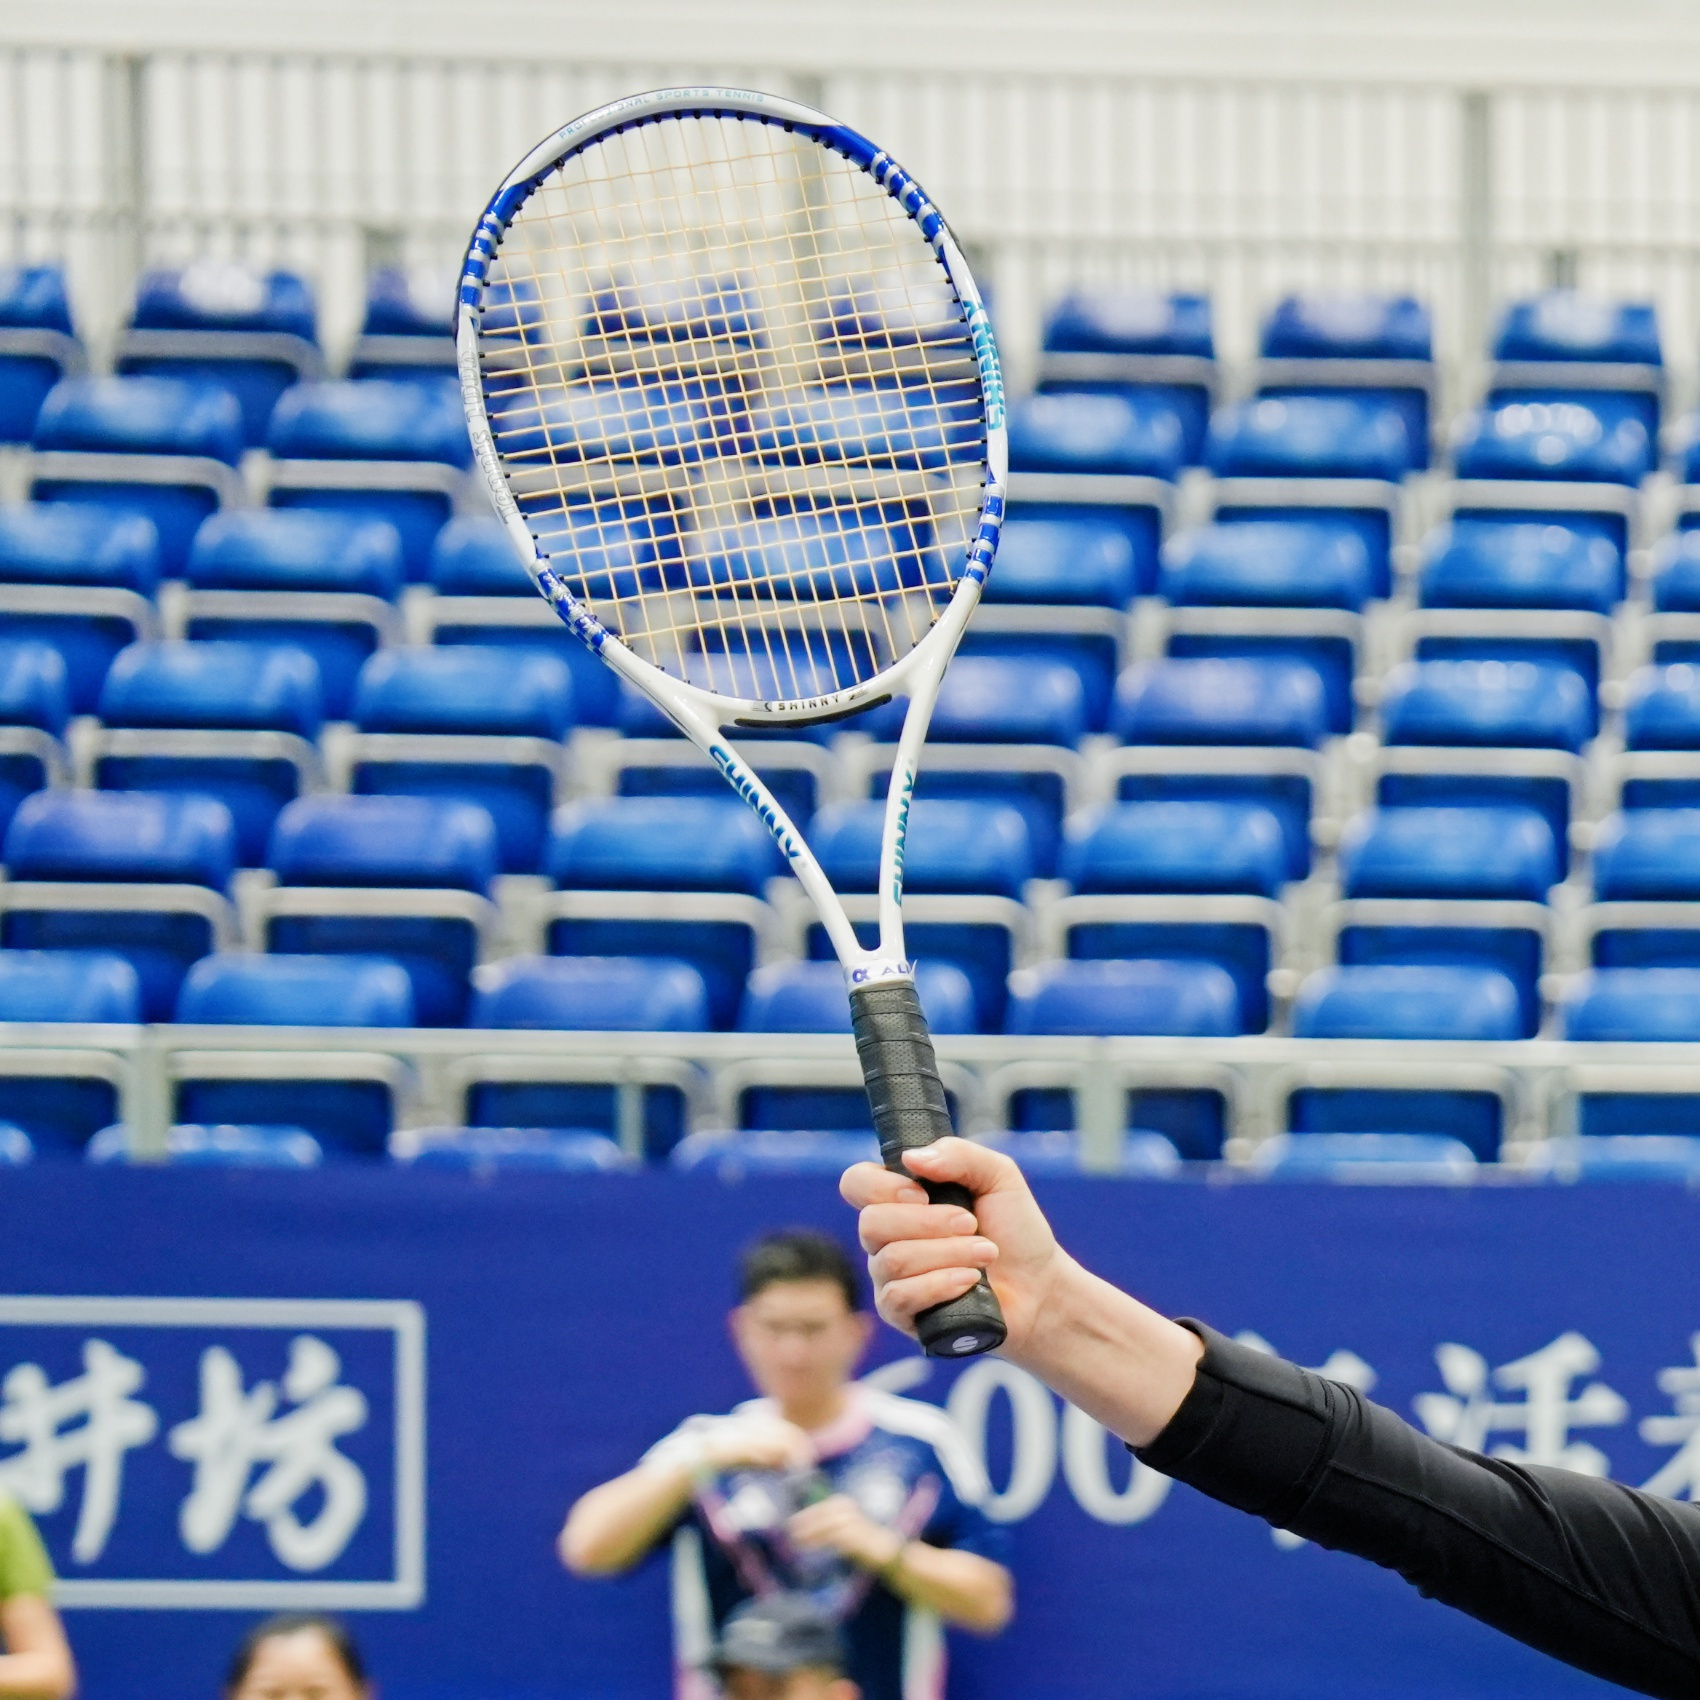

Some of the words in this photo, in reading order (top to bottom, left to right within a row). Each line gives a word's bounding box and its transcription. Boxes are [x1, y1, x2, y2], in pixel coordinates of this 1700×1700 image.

[656, 89, 709, 101] SPORTS
[716, 90, 765, 103] TENNIS
[778, 694, 840, 711] SHINNY
